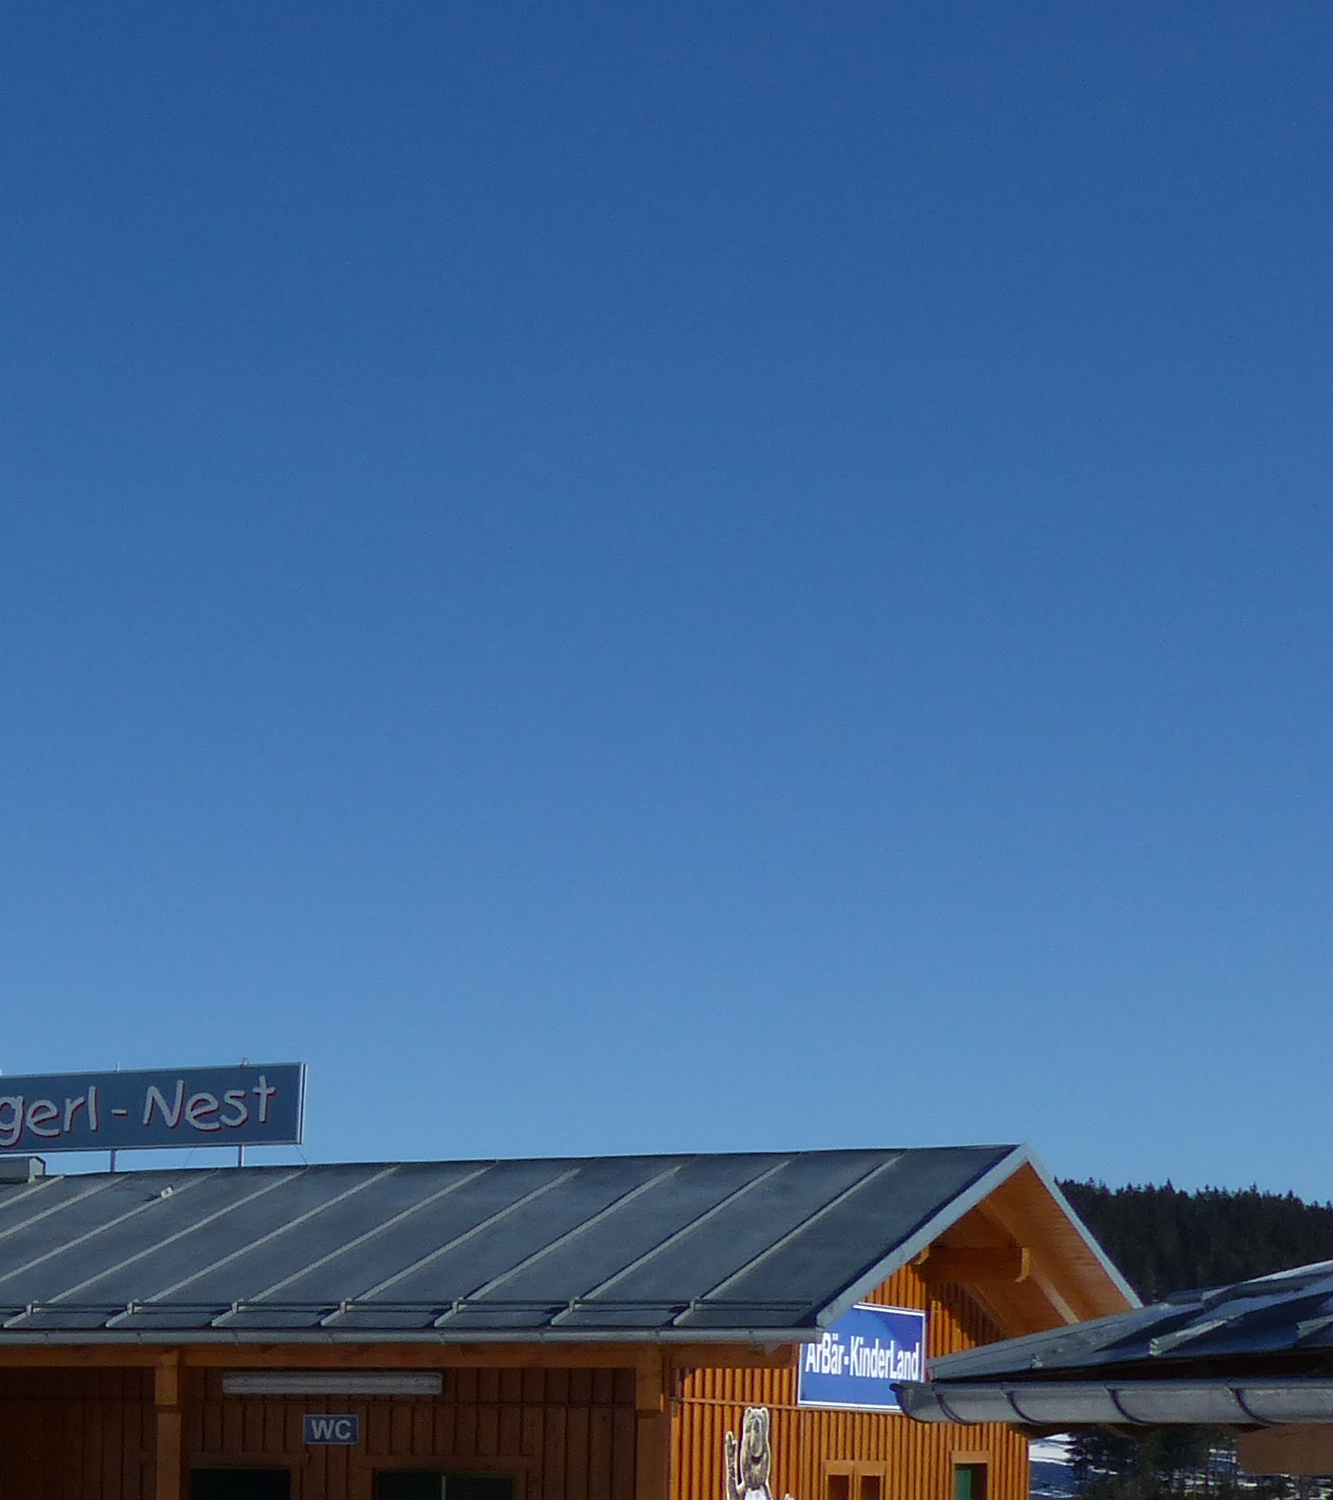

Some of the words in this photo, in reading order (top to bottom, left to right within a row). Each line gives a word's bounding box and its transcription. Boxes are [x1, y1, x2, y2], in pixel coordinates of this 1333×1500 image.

[111, 1107, 129, 1117] -
[142, 1073, 278, 1132] Nest
[311, 1418, 352, 1440] WC
